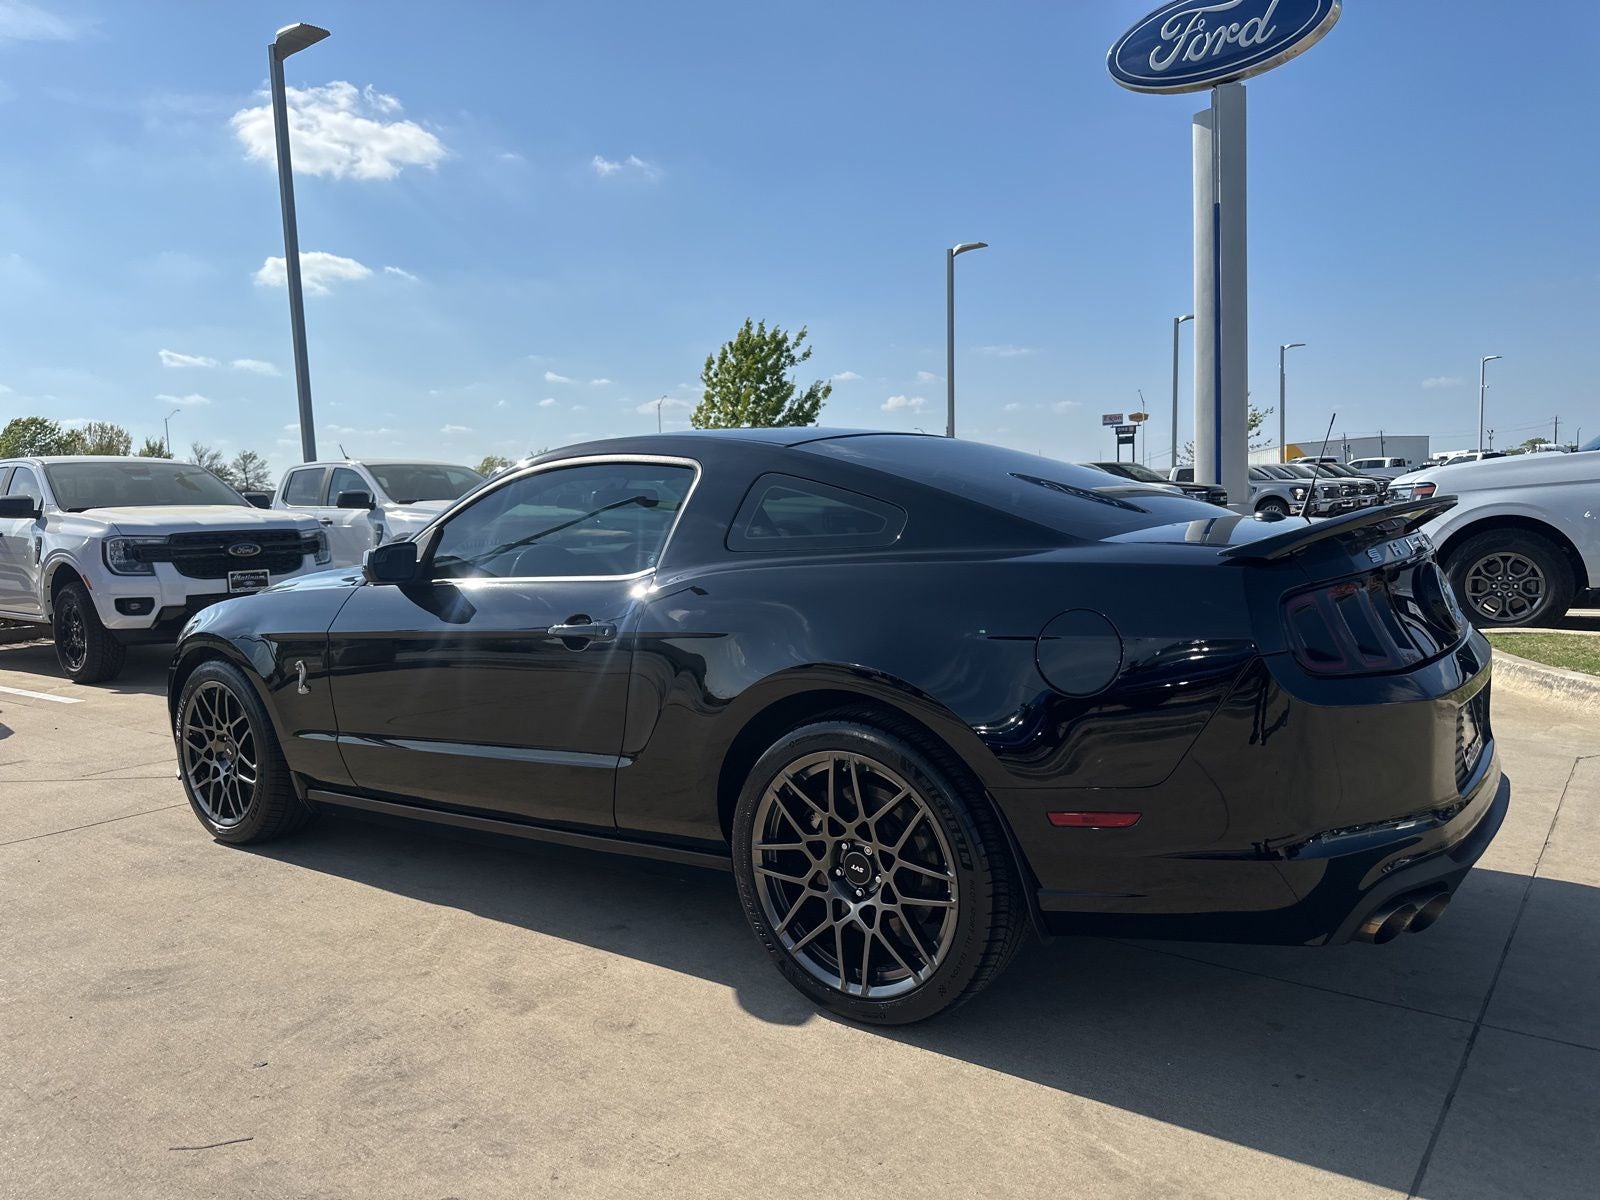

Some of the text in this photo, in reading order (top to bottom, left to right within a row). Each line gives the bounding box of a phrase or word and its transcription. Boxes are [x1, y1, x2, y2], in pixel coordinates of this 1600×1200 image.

[1149, 0, 1277, 71] Ford
[237, 545, 254, 554] Ford
[232, 573, 265, 581] Platinum
[850, 864, 865, 873] SVT
